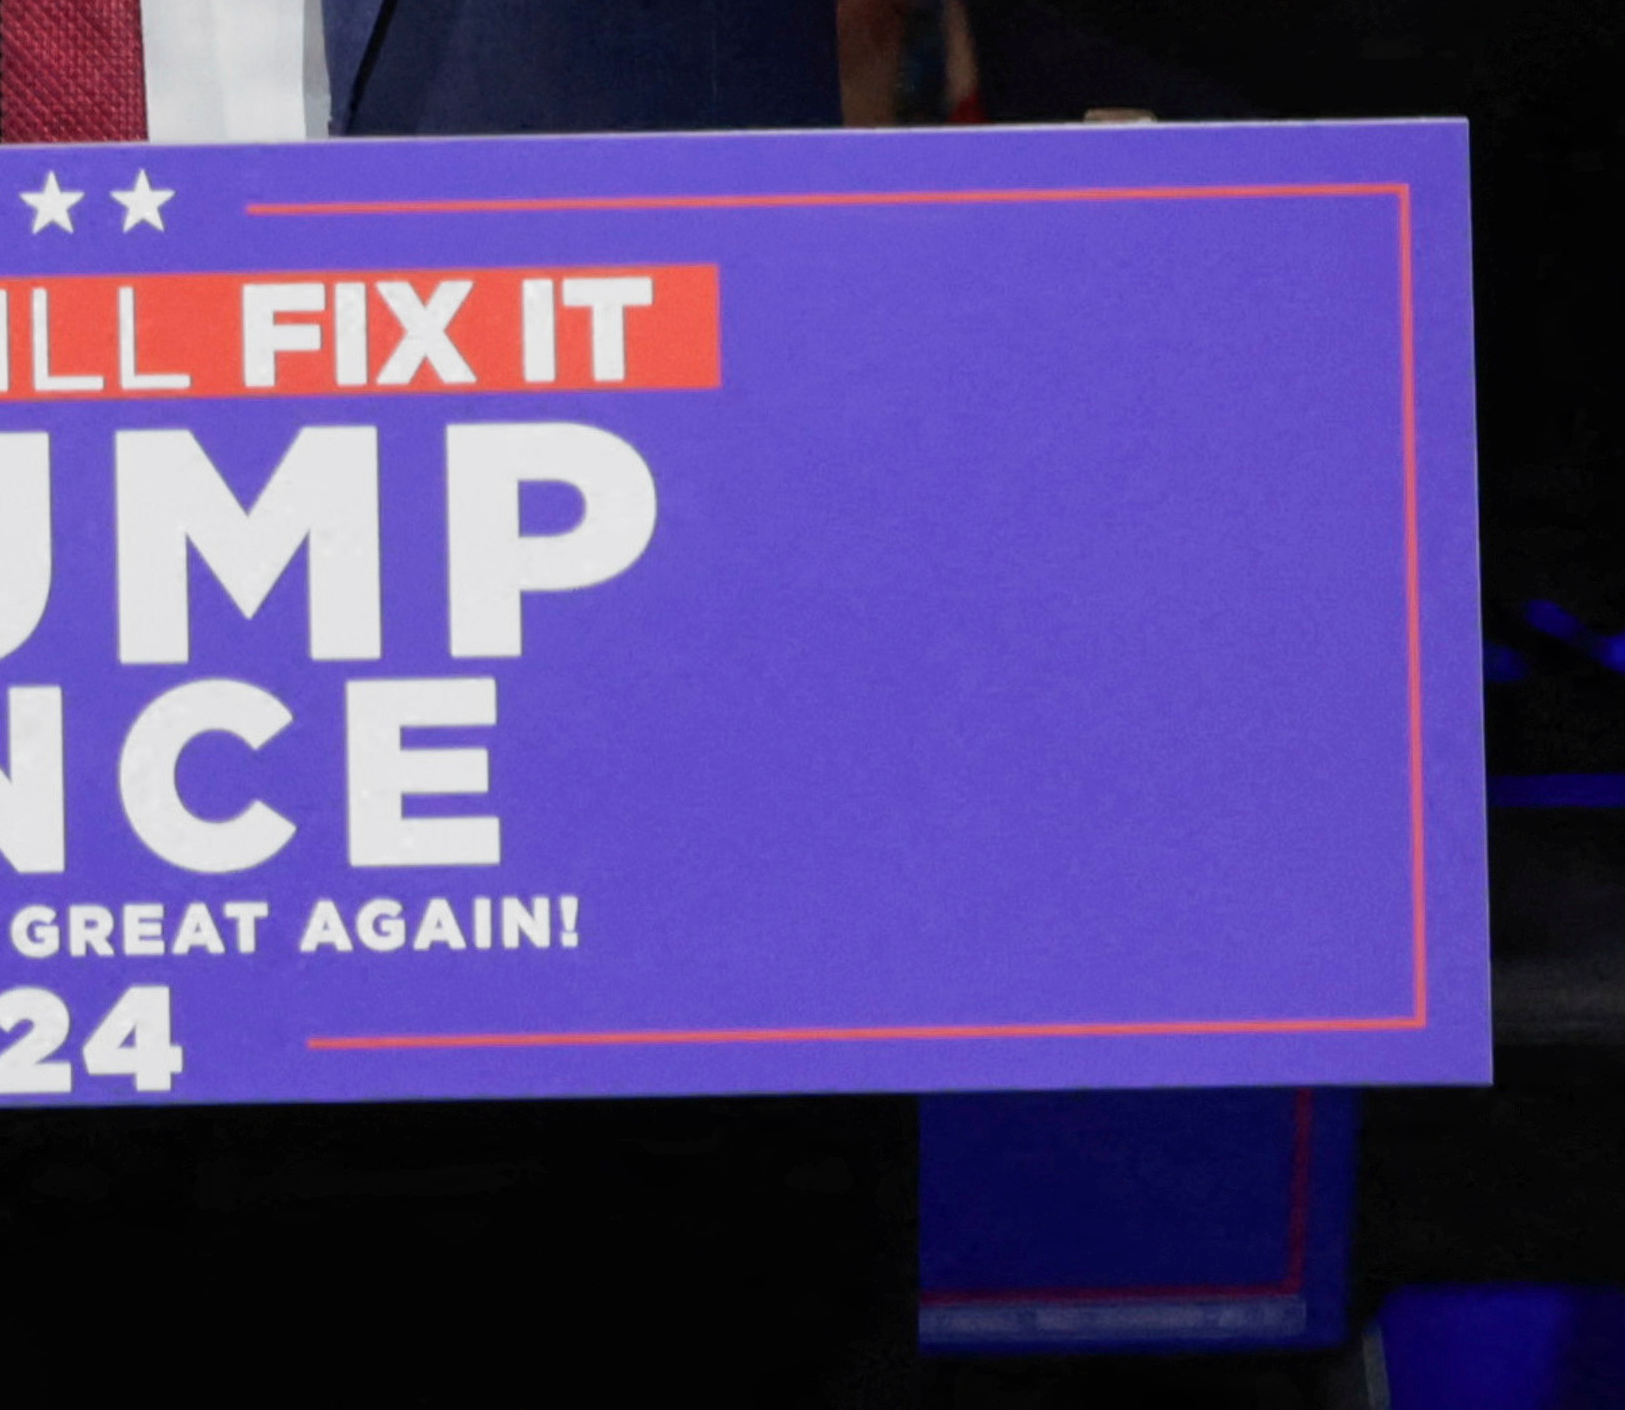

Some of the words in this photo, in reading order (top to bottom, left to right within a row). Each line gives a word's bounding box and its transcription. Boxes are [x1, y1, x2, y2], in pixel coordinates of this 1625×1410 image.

[242, 280, 477, 388] FIX
[522, 275, 653, 383] IT
[10, 901, 269, 959] GREAT
[299, 895, 581, 953] AGAIN!
